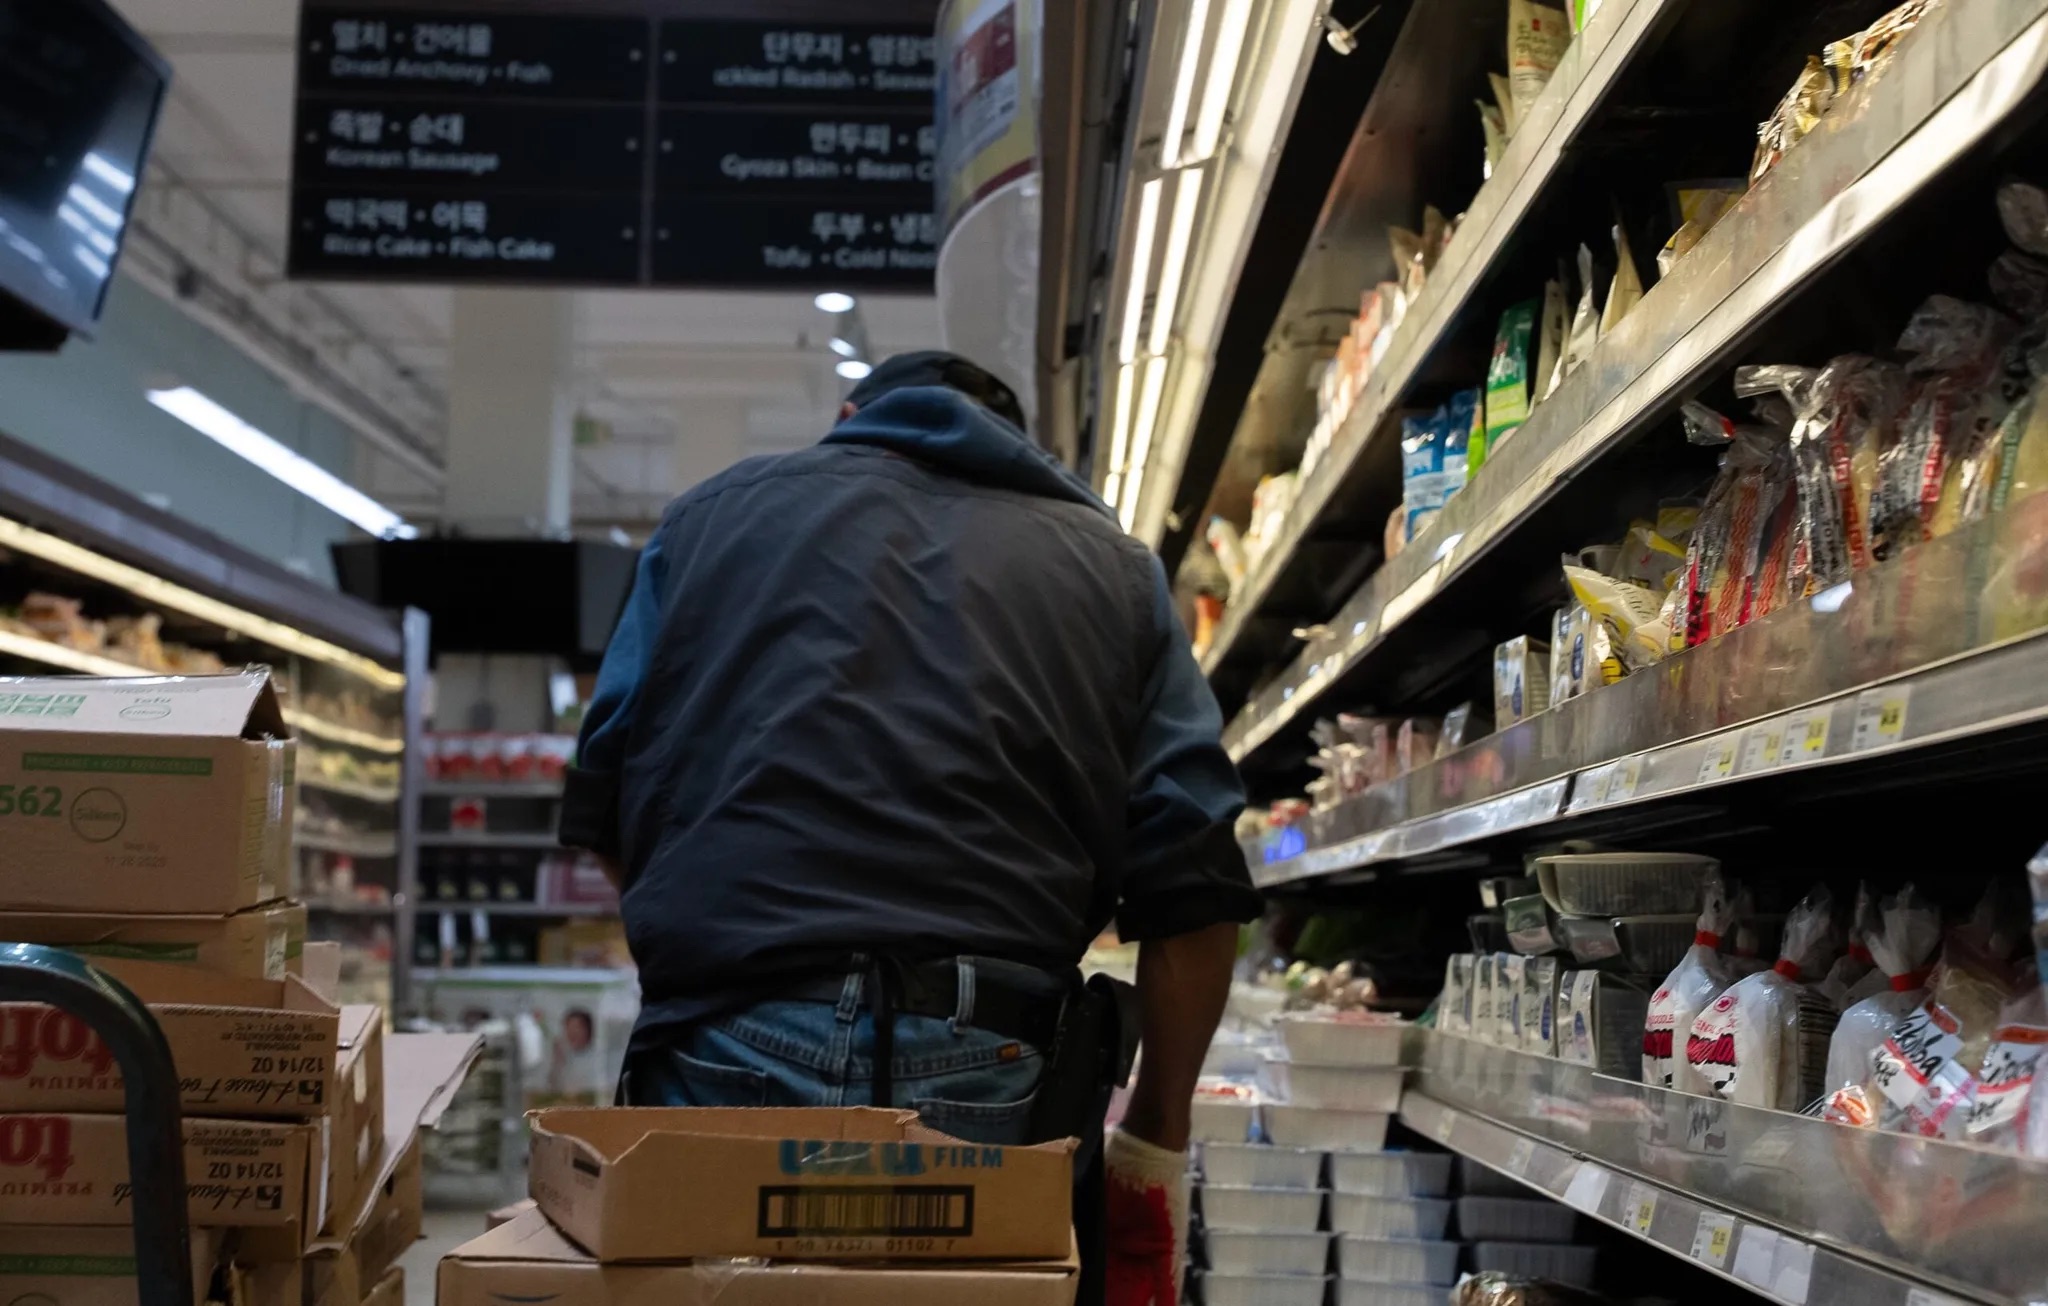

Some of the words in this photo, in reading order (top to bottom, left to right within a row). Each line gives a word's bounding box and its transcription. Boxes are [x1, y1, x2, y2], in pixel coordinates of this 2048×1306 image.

[394, 57, 488, 86] Anchovy
[326, 147, 404, 168] Korean
[408, 148, 499, 175] Sausage
[794, 156, 839, 177] Skin
[857, 157, 911, 179] Bean
[812, 213, 865, 243] 두부
[323, 234, 372, 255] Rice
[375, 235, 432, 258] Cake
[449, 236, 495, 258] Fish
[498, 237, 554, 260] Cake
[763, 246, 811, 268] Tofu
[836, 247, 885, 268] Cold
[251, 1057, 274, 1073] OZ
[279, 1057, 325, 1073] 12/14
[224, 1079, 298, 1104] House
[935, 1146, 1003, 1167] FIRM
[208, 1163, 231, 1178] OZ
[237, 1163, 283, 1178] 12/14
